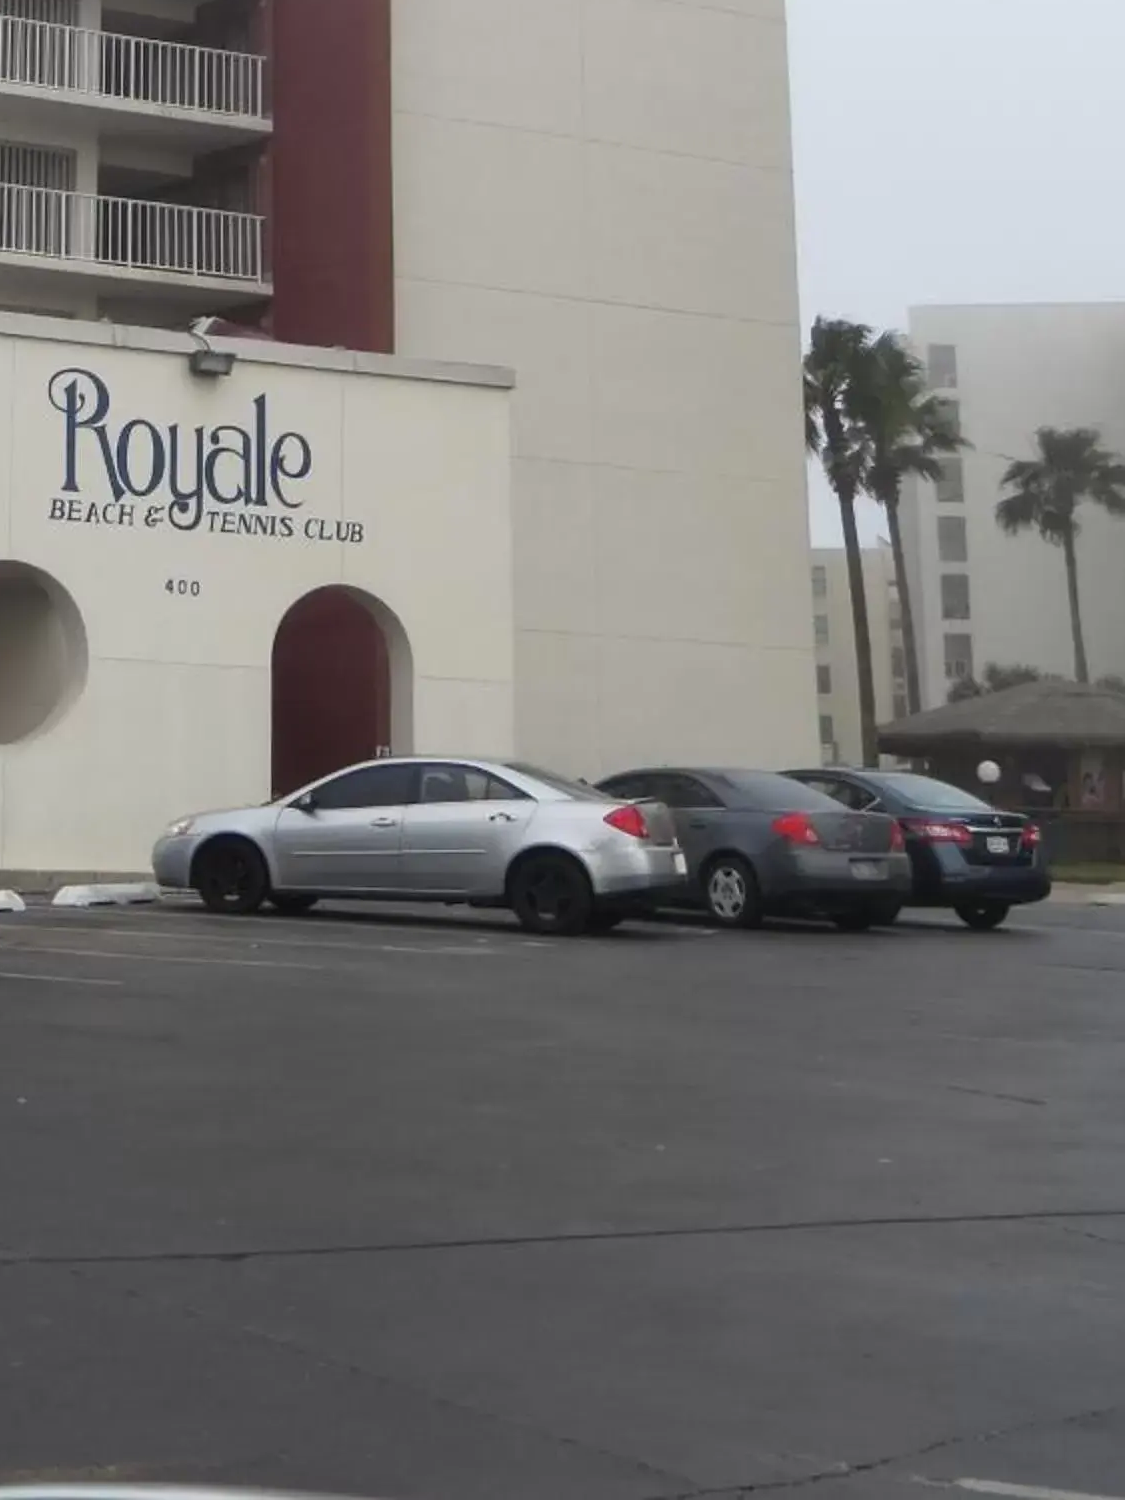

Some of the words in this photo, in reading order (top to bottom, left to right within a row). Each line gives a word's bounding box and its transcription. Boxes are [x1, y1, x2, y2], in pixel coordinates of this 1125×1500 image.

[48, 367, 312, 531] Royale
[49, 498, 135, 526] BEACH
[144, 505, 165, 527] &
[206, 511, 294, 537] TENNIS
[304, 517, 364, 542] CLUB
[164, 579, 200, 596] 400
